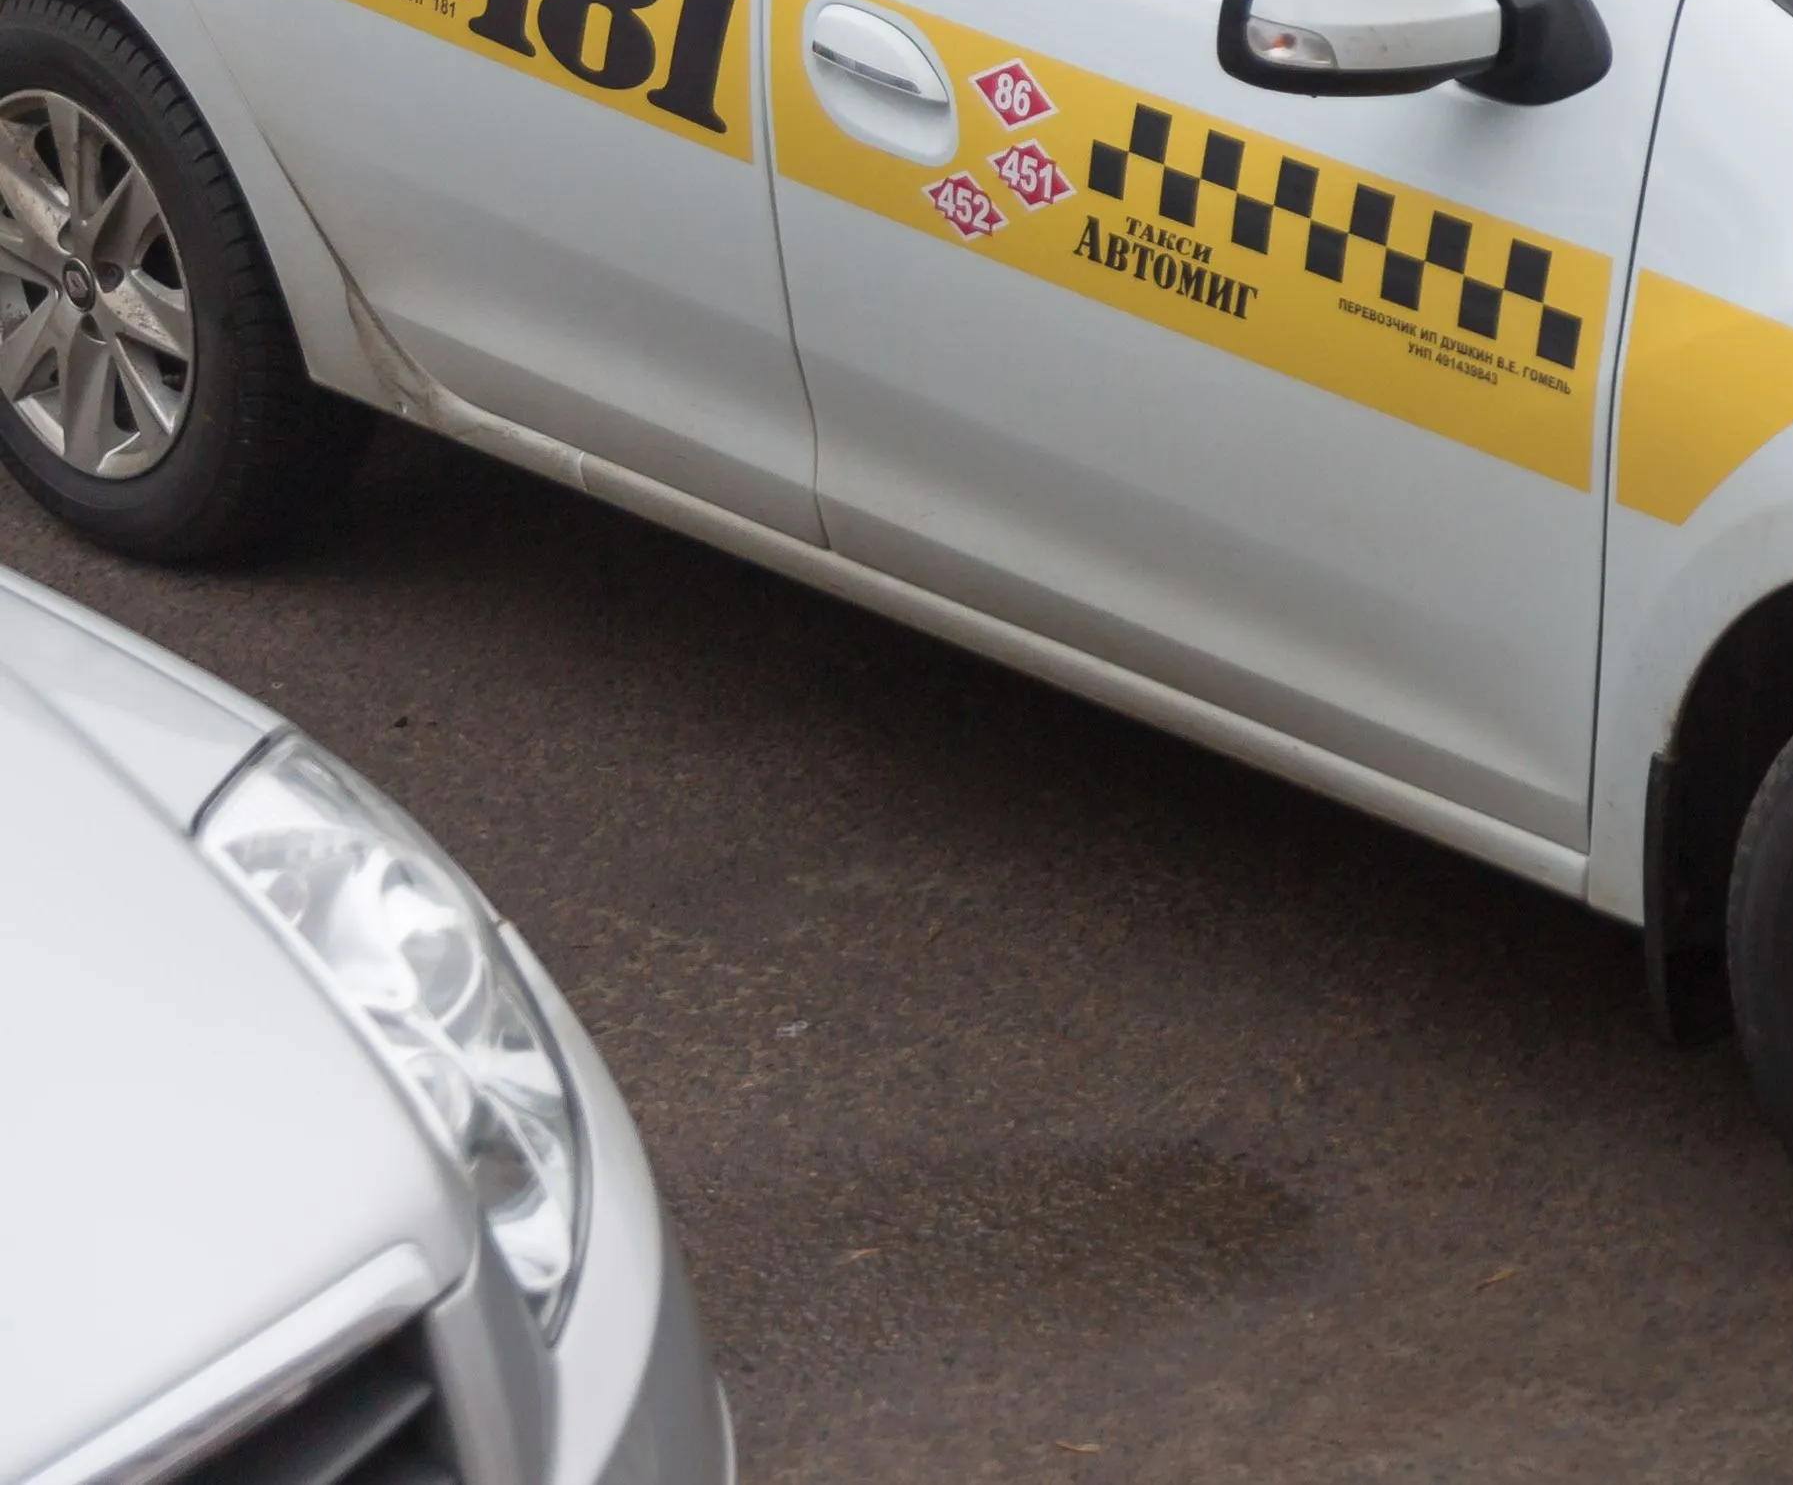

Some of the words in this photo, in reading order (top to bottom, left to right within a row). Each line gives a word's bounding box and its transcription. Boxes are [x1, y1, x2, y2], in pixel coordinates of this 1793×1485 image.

[994, 73, 1031, 116] 86
[1001, 152, 1055, 200] 451
[937, 184, 992, 229] 452
[1126, 216, 1214, 264] ТАКСИ
[1073, 215, 1259, 320] АВТОМИГ
[1338, 297, 1417, 337] ПЕРЕВОЗЧИК
[1420, 327, 1437, 345] ИП
[1440, 335, 1493, 365] ДУШКИН
[1522, 366, 1571, 396] ГОМЕЛЬ
[1407, 341, 1433, 362] УНП
